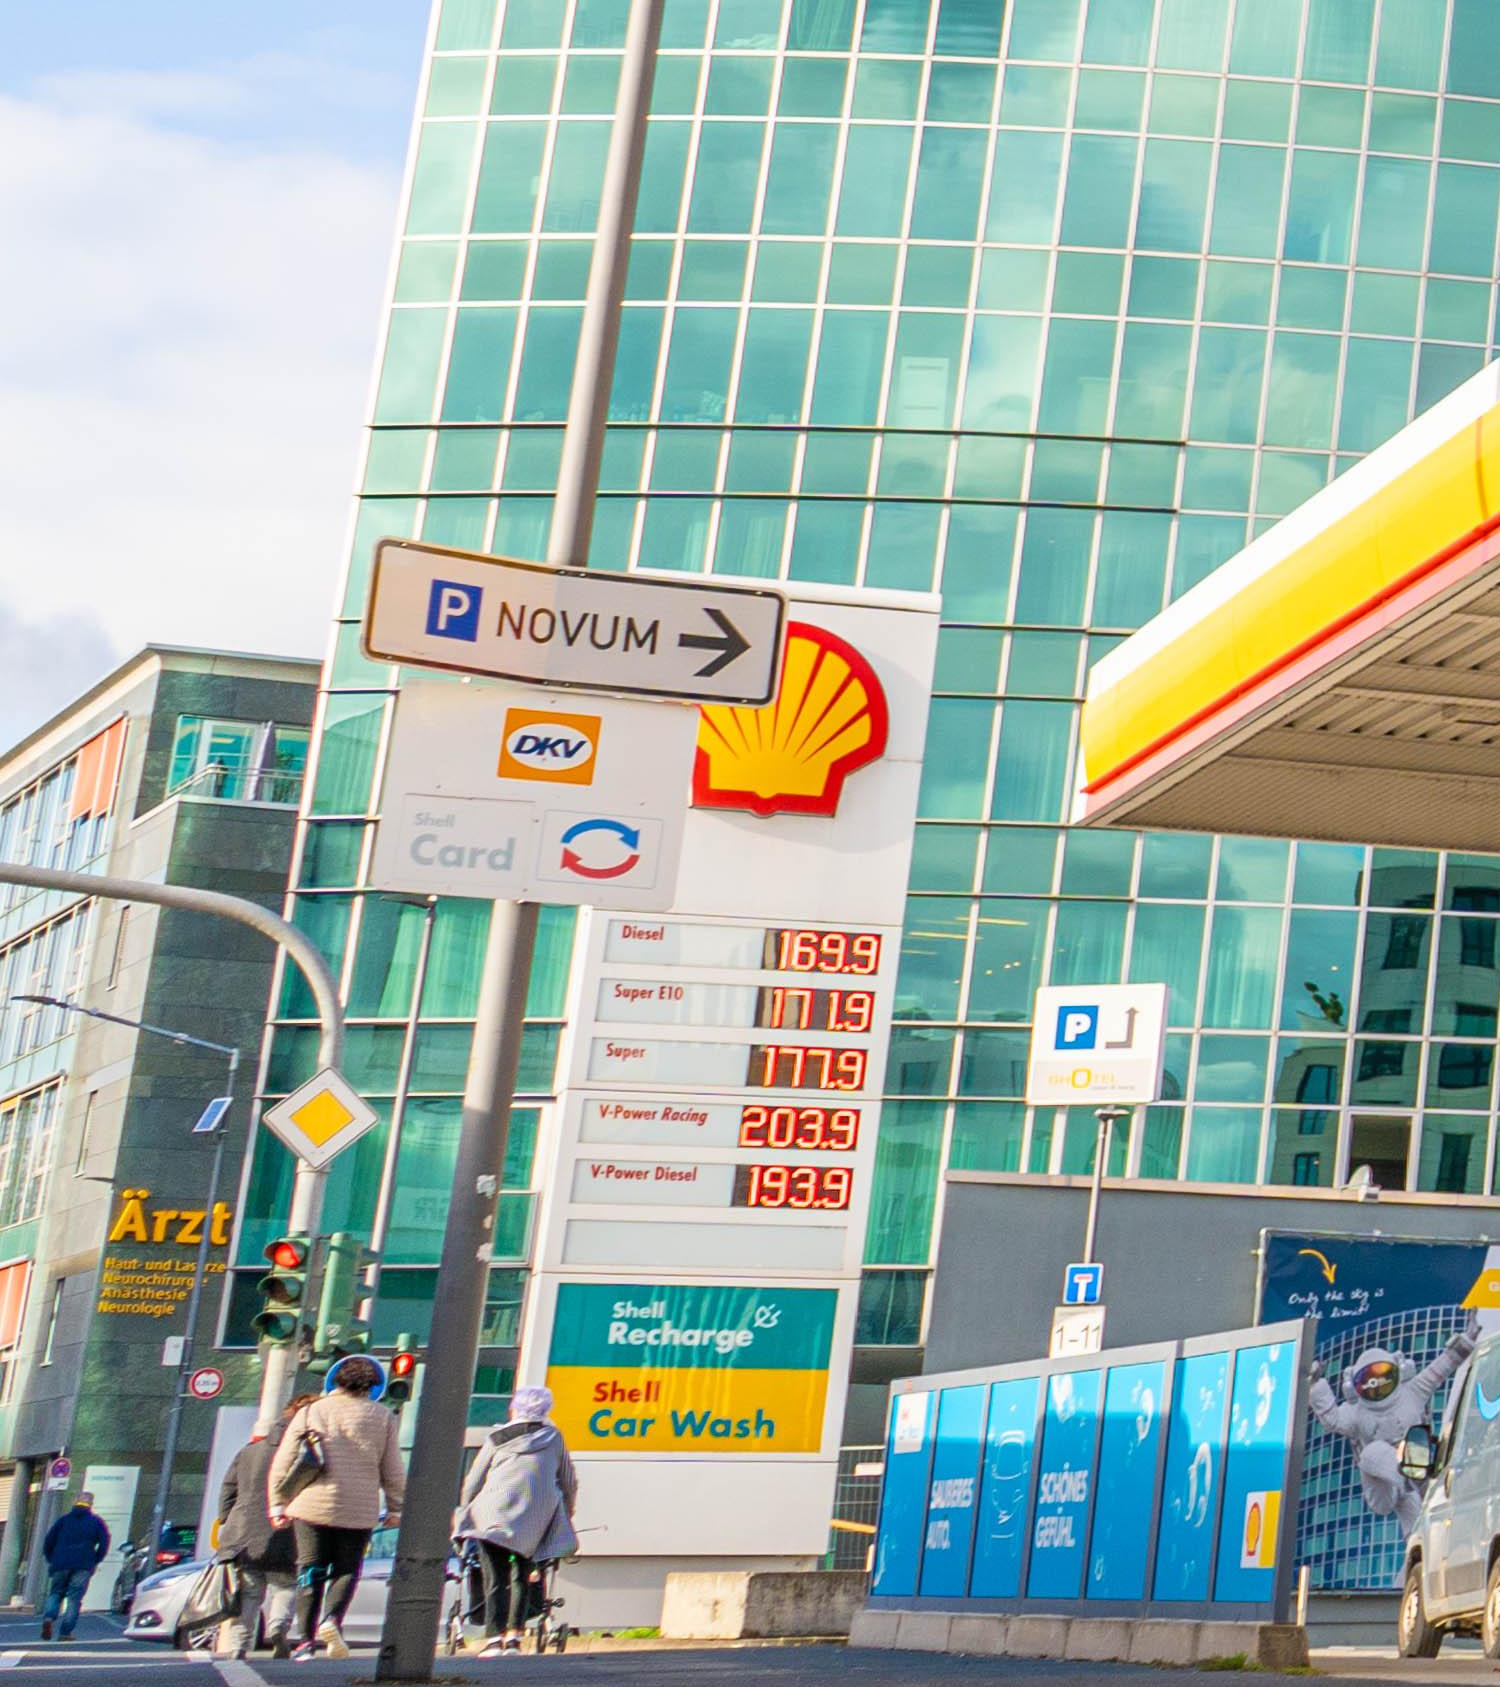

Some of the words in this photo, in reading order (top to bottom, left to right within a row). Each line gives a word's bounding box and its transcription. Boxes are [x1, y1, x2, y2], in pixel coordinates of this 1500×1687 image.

[438, 587, 471, 630] P
[497, 601, 660, 655] NOVUM
[512, 733, 588, 760] DKV
[414, 811, 455, 829] Shell
[409, 834, 515, 873] Card
[622, 925, 664, 941] Diesel
[779, 929, 879, 974] 169.9
[615, 984, 654, 1001] Super
[659, 985, 684, 1001] E10
[1064, 1013, 1092, 1042] P
[606, 1043, 646, 1060] Super
[763, 1045, 865, 1090] 177.9
[599, 1105, 657, 1121] V-Power
[661, 1107, 708, 1126] Racing
[738, 1105, 857, 1150] 203.9
[591, 1165, 649, 1181] V-Power
[655, 1166, 697, 1182] Diesel
[748, 1164, 850, 1210] 193.9
[612, 1300, 665, 1319] Shell
[1325, 1290, 1344, 1301] the
[608, 1321, 753, 1354] Recharge
[593, 1381, 661, 1403] Shell
[588, 1409, 655, 1438] Car
[671, 1409, 775, 1438] Wash
